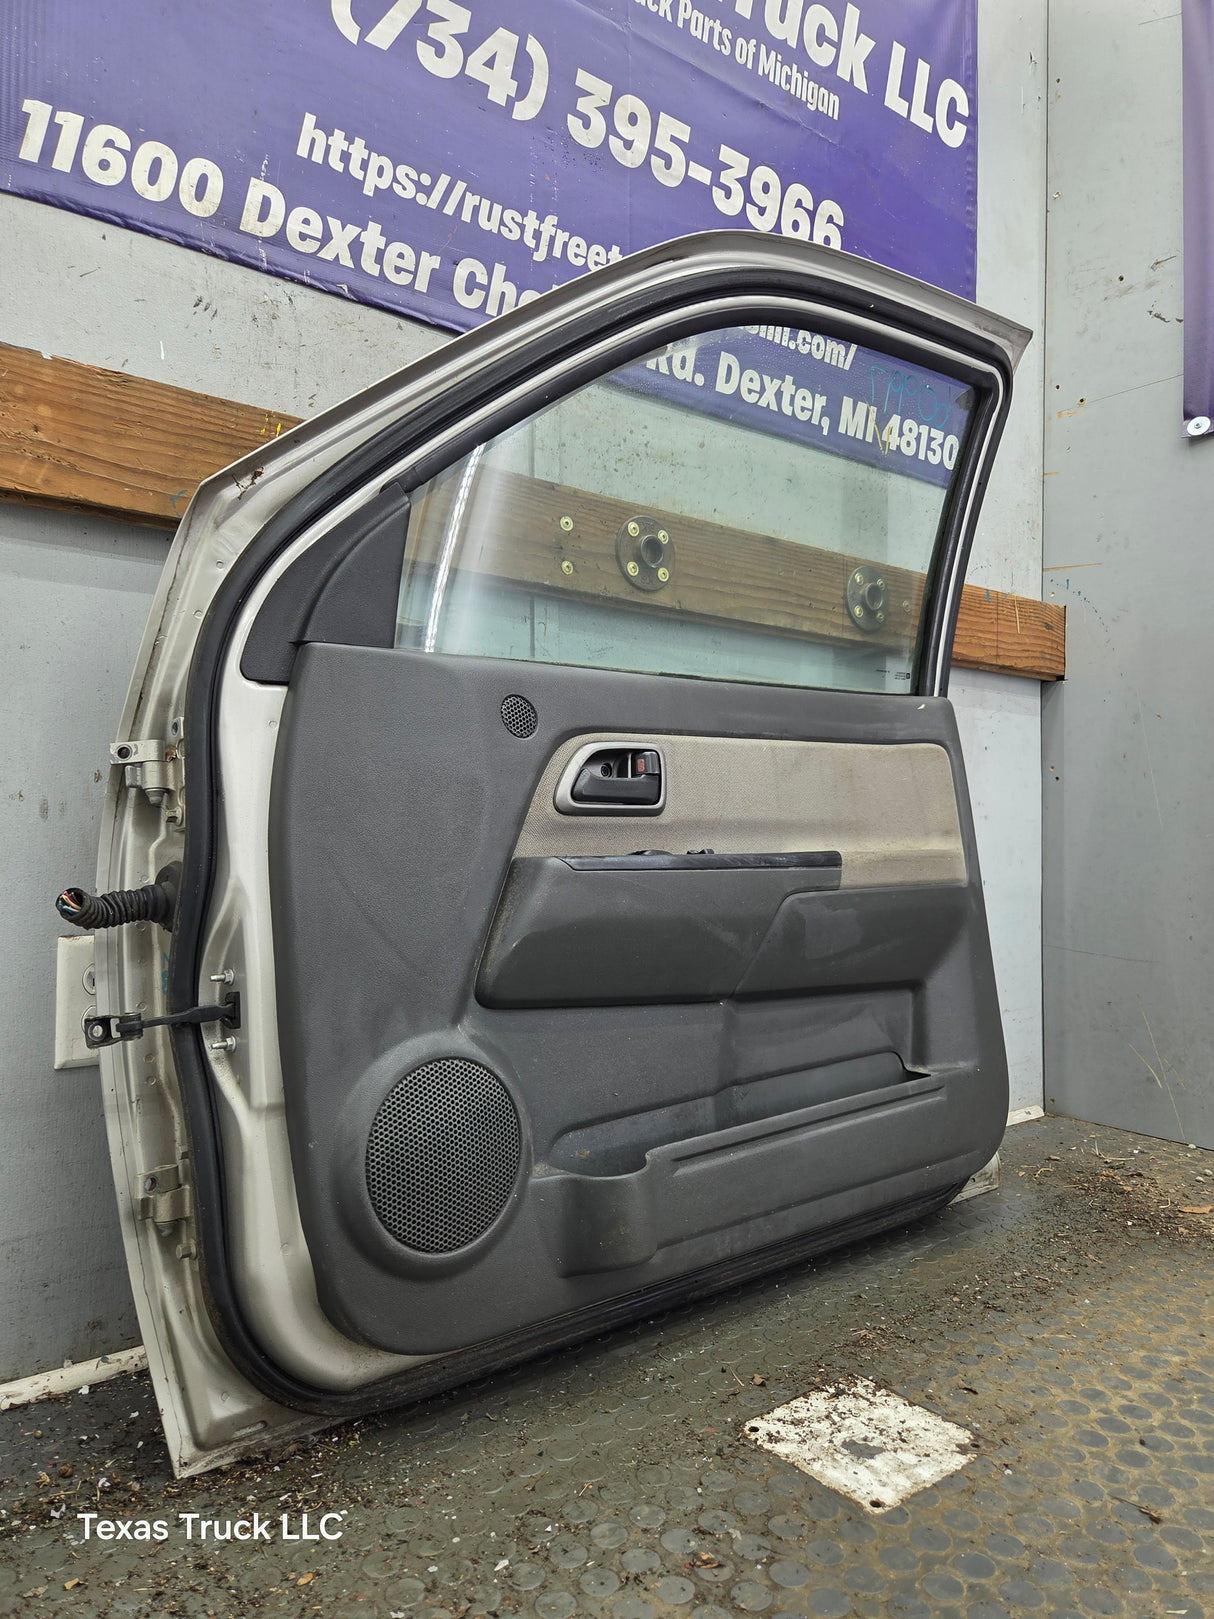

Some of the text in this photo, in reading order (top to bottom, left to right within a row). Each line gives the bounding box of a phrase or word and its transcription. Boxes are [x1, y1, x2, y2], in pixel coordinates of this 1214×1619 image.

[331, 0, 845, 250] (734) 395-3966
[677, 0, 733, 56] Parts
[735, 37, 757, 69] of
[758, 43, 840, 121] Michigan
[884, 41, 969, 148] LLC
[18, 99, 224, 218] 11600
[239, 177, 441, 293] Dexter
[715, 351, 829, 436] Dexter,
[838, 396, 877, 443] MI
[881, 414, 960, 471] 48130
